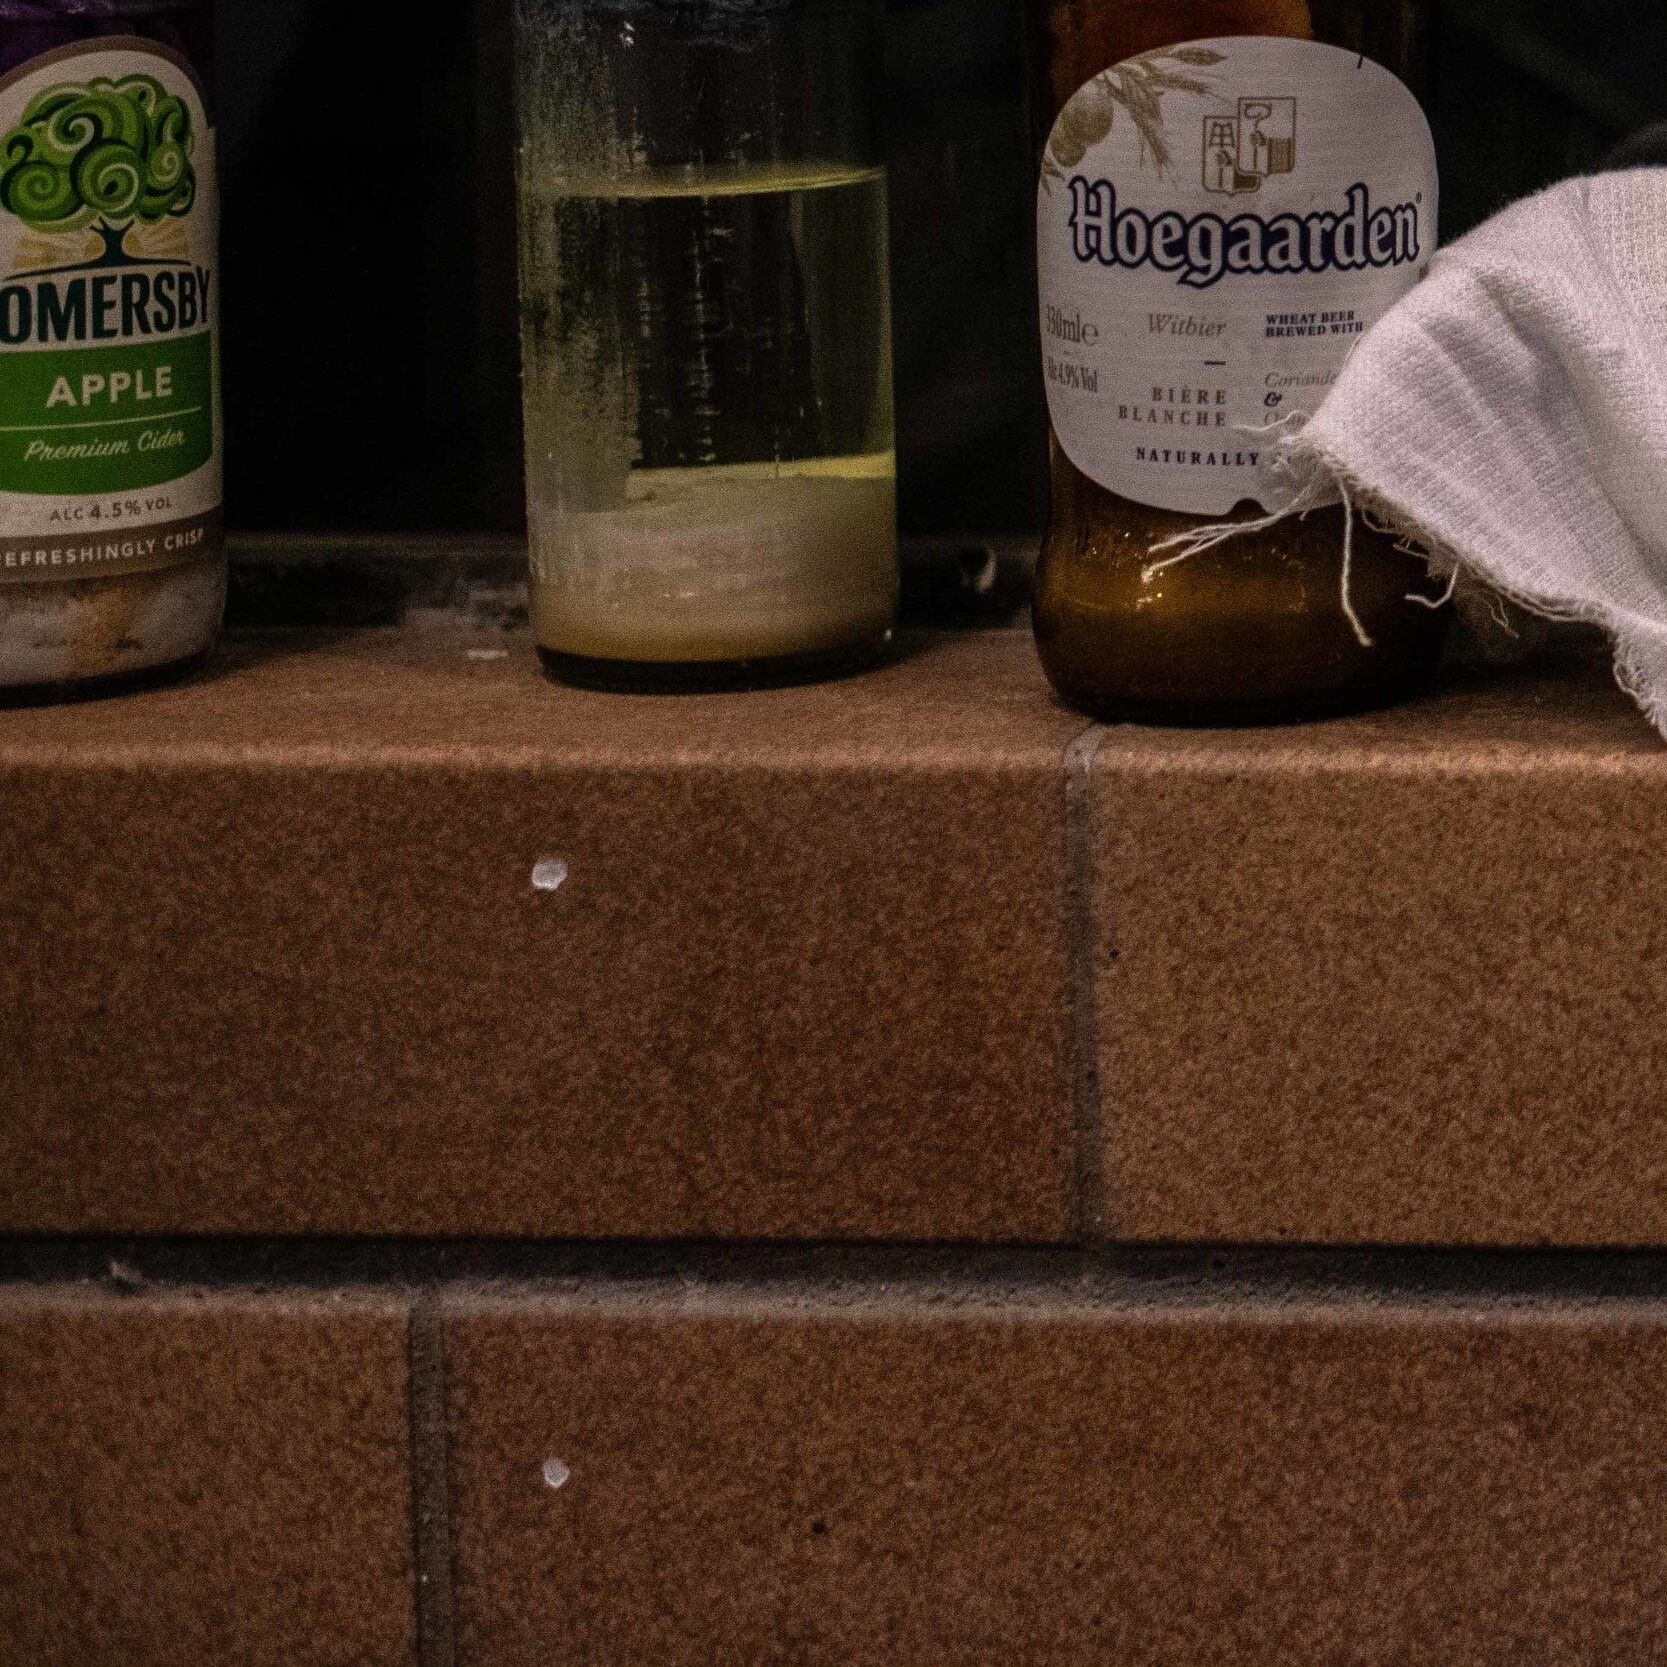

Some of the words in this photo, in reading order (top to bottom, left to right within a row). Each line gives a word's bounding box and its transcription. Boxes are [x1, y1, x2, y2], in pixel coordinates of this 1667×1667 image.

[1069, 175, 1420, 288] Hoegaarden
[0, 265, 210, 344] OMERSBY
[1264, 313, 1318, 326] WHEAT
[1321, 309, 1356, 324] BEER
[1264, 324, 1328, 339] BREWED
[1330, 320, 1365, 335] WITH
[46, 365, 174, 409] APPLE
[1264, 369, 1339, 389] Coriande
[1151, 383, 1228, 406] BIÈRE
[1118, 405, 1227, 427] BLANCHE
[24, 438, 130, 462] Premium
[137, 427, 187, 453] Cider
[1135, 446, 1261, 467] NATURALLY
[51, 506, 84, 522] ALC
[145, 496, 172, 511] VOL
[4, 539, 156, 568] EFRESHINGLY
